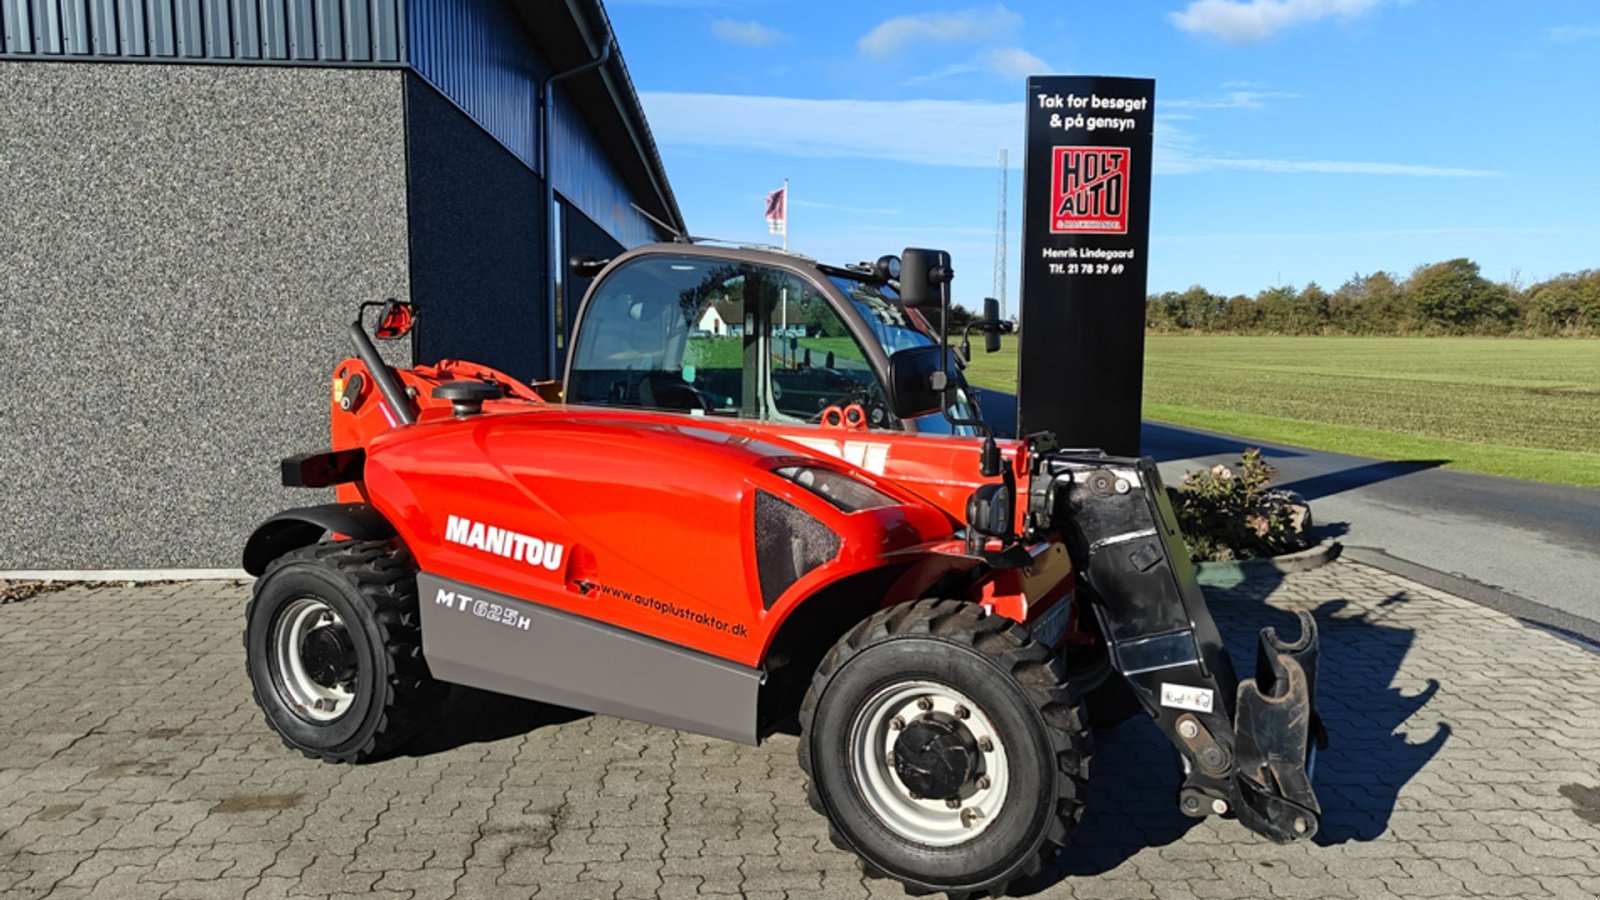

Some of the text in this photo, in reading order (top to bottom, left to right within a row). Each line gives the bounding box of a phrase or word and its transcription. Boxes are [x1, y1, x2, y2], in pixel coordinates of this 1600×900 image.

[1037, 93, 1148, 113] Tak for besøget
[1049, 113, 1135, 132] & på gensyn
[1061, 151, 1123, 196] HOLT
[1056, 172, 1123, 216] AUTO
[1042, 247, 1134, 260] Henrik Lindegaard
[1067, 263, 1079, 274] 21
[1080, 263, 1094, 274] 78
[1096, 263, 1109, 274] 29
[1111, 263, 1125, 274] 69
[445, 514, 564, 571] MANITOU
[600, 584, 748, 638] www.autoplustraktor.dk
